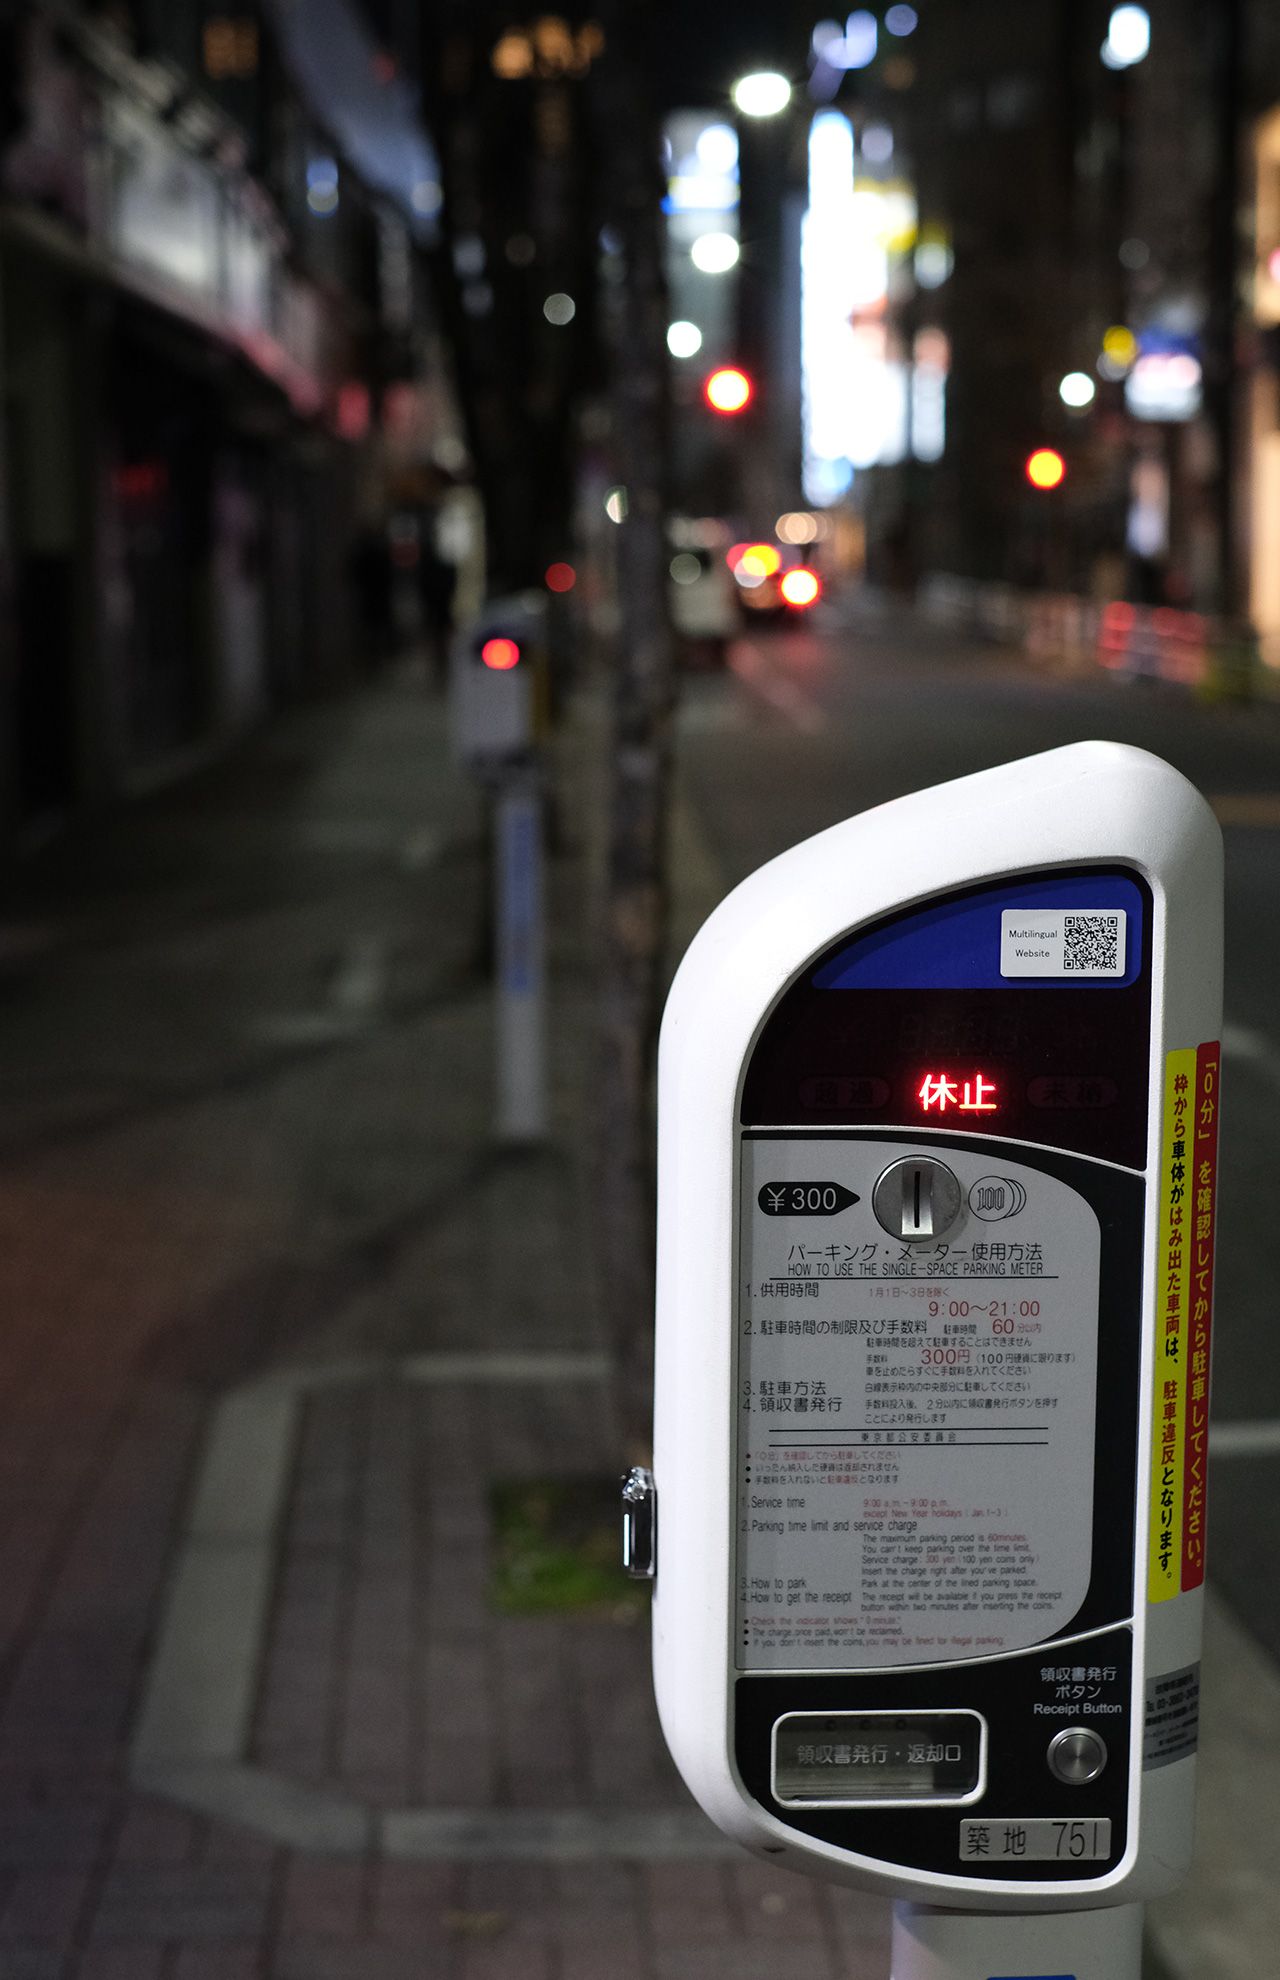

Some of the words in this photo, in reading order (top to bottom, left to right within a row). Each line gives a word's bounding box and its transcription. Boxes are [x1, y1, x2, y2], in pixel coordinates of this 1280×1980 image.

[1008, 929, 1058, 940] Multilingual
[1015, 949, 1050, 958] Website
[918, 1074, 998, 1111] 休止
[976, 1186, 1006, 1211] 100
[787, 1263, 812, 1277] HOW
[816, 1263, 830, 1276] TO
[834, 1263, 854, 1276] USE
[859, 1262, 877, 1276] THE
[963, 1262, 1006, 1275] PARKING
[1010, 1262, 1044, 1275] METER
[864, 1413, 947, 1424] ことにより発行します
[786, 1497, 806, 1508] time
[863, 1509, 888, 1519] except
[891, 1509, 908, 1518] New
[911, 1509, 929, 1518] Year
[931, 1508, 963, 1519] holidays
[787, 1520, 808, 1531] time
[811, 1520, 830, 1531] limit
[833, 1520, 850, 1531] and
[853, 1520, 884, 1532] service
[887, 1520, 918, 1534] charge
[863, 1534, 877, 1543] The
[880, 1534, 916, 1543] maximum
[919, 1534, 948, 1545] parking
[951, 1533, 975, 1544] period
[978, 1534, 985, 1542] is
[862, 1545, 877, 1554] You
[904, 1545, 923, 1555] keep
[926, 1544, 955, 1556] parking
[958, 1545, 974, 1553] over
[978, 1543, 991, 1552] the
[994, 1543, 1010, 1552] time
[861, 1554, 890, 1565] Service
[926, 1554, 940, 1564] 300
[979, 1556, 993, 1566] yen
[996, 1555, 1016, 1564] coins
[861, 1567, 882, 1576] Insert
[885, 1567, 898, 1576] the
[900, 1567, 927, 1578] charge
[930, 1566, 947, 1578] right
[950, 1566, 967, 1575] after
[774, 1578, 784, 1590] to
[787, 1577, 807, 1590] park
[861, 1579, 878, 1589] Park
[881, 1579, 890, 1588] at
[892, 1579, 905, 1588] the
[907, 1579, 932, 1588] center
[934, 1579, 943, 1588] of
[945, 1578, 958, 1588] the
[960, 1578, 980, 1588] lined
[982, 1578, 1010, 1589] parking
[773, 1592, 784, 1604] to
[786, 1592, 802, 1607] get
[804, 1592, 820, 1603] the
[822, 1591, 853, 1605] receipt
[861, 1591, 877, 1601] The
[879, 1592, 905, 1603] receipt
[907, 1592, 921, 1601] will
[923, 1592, 934, 1601] be
[936, 1591, 969, 1601] available
[980, 1592, 995, 1602] you
[997, 1592, 1018, 1602] press
[1021, 1591, 1034, 1601] the
[860, 1602, 885, 1612] button
[887, 1602, 910, 1612] within
[912, 1602, 927, 1612] two
[929, 1602, 960, 1612] minutes
[961, 1601, 979, 1611] after
[982, 1601, 1015, 1613] inserting
[1017, 1601, 1030, 1611] the
[751, 1616, 776, 1626] Check
[779, 1617, 793, 1625] the
[832, 1616, 858, 1625] shows
[753, 1627, 766, 1636] The
[856, 1627, 866, 1636] be
[762, 1639, 777, 1648] you
[803, 1638, 825, 1648] insert
[827, 1638, 841, 1647] the
[883, 1638, 900, 1648] may
[901, 1637, 913, 1647] be
[914, 1636, 935, 1646] fined
[937, 1636, 948, 1646] for
[950, 1635, 973, 1647] illegal
[1039, 1666, 1117, 1683] 領収書発行
[1055, 1685, 1101, 1700] ボタン
[1033, 1703, 1080, 1716] Receipt
[1082, 1702, 1123, 1715] Button
[1052, 1821, 1099, 1858] 751
